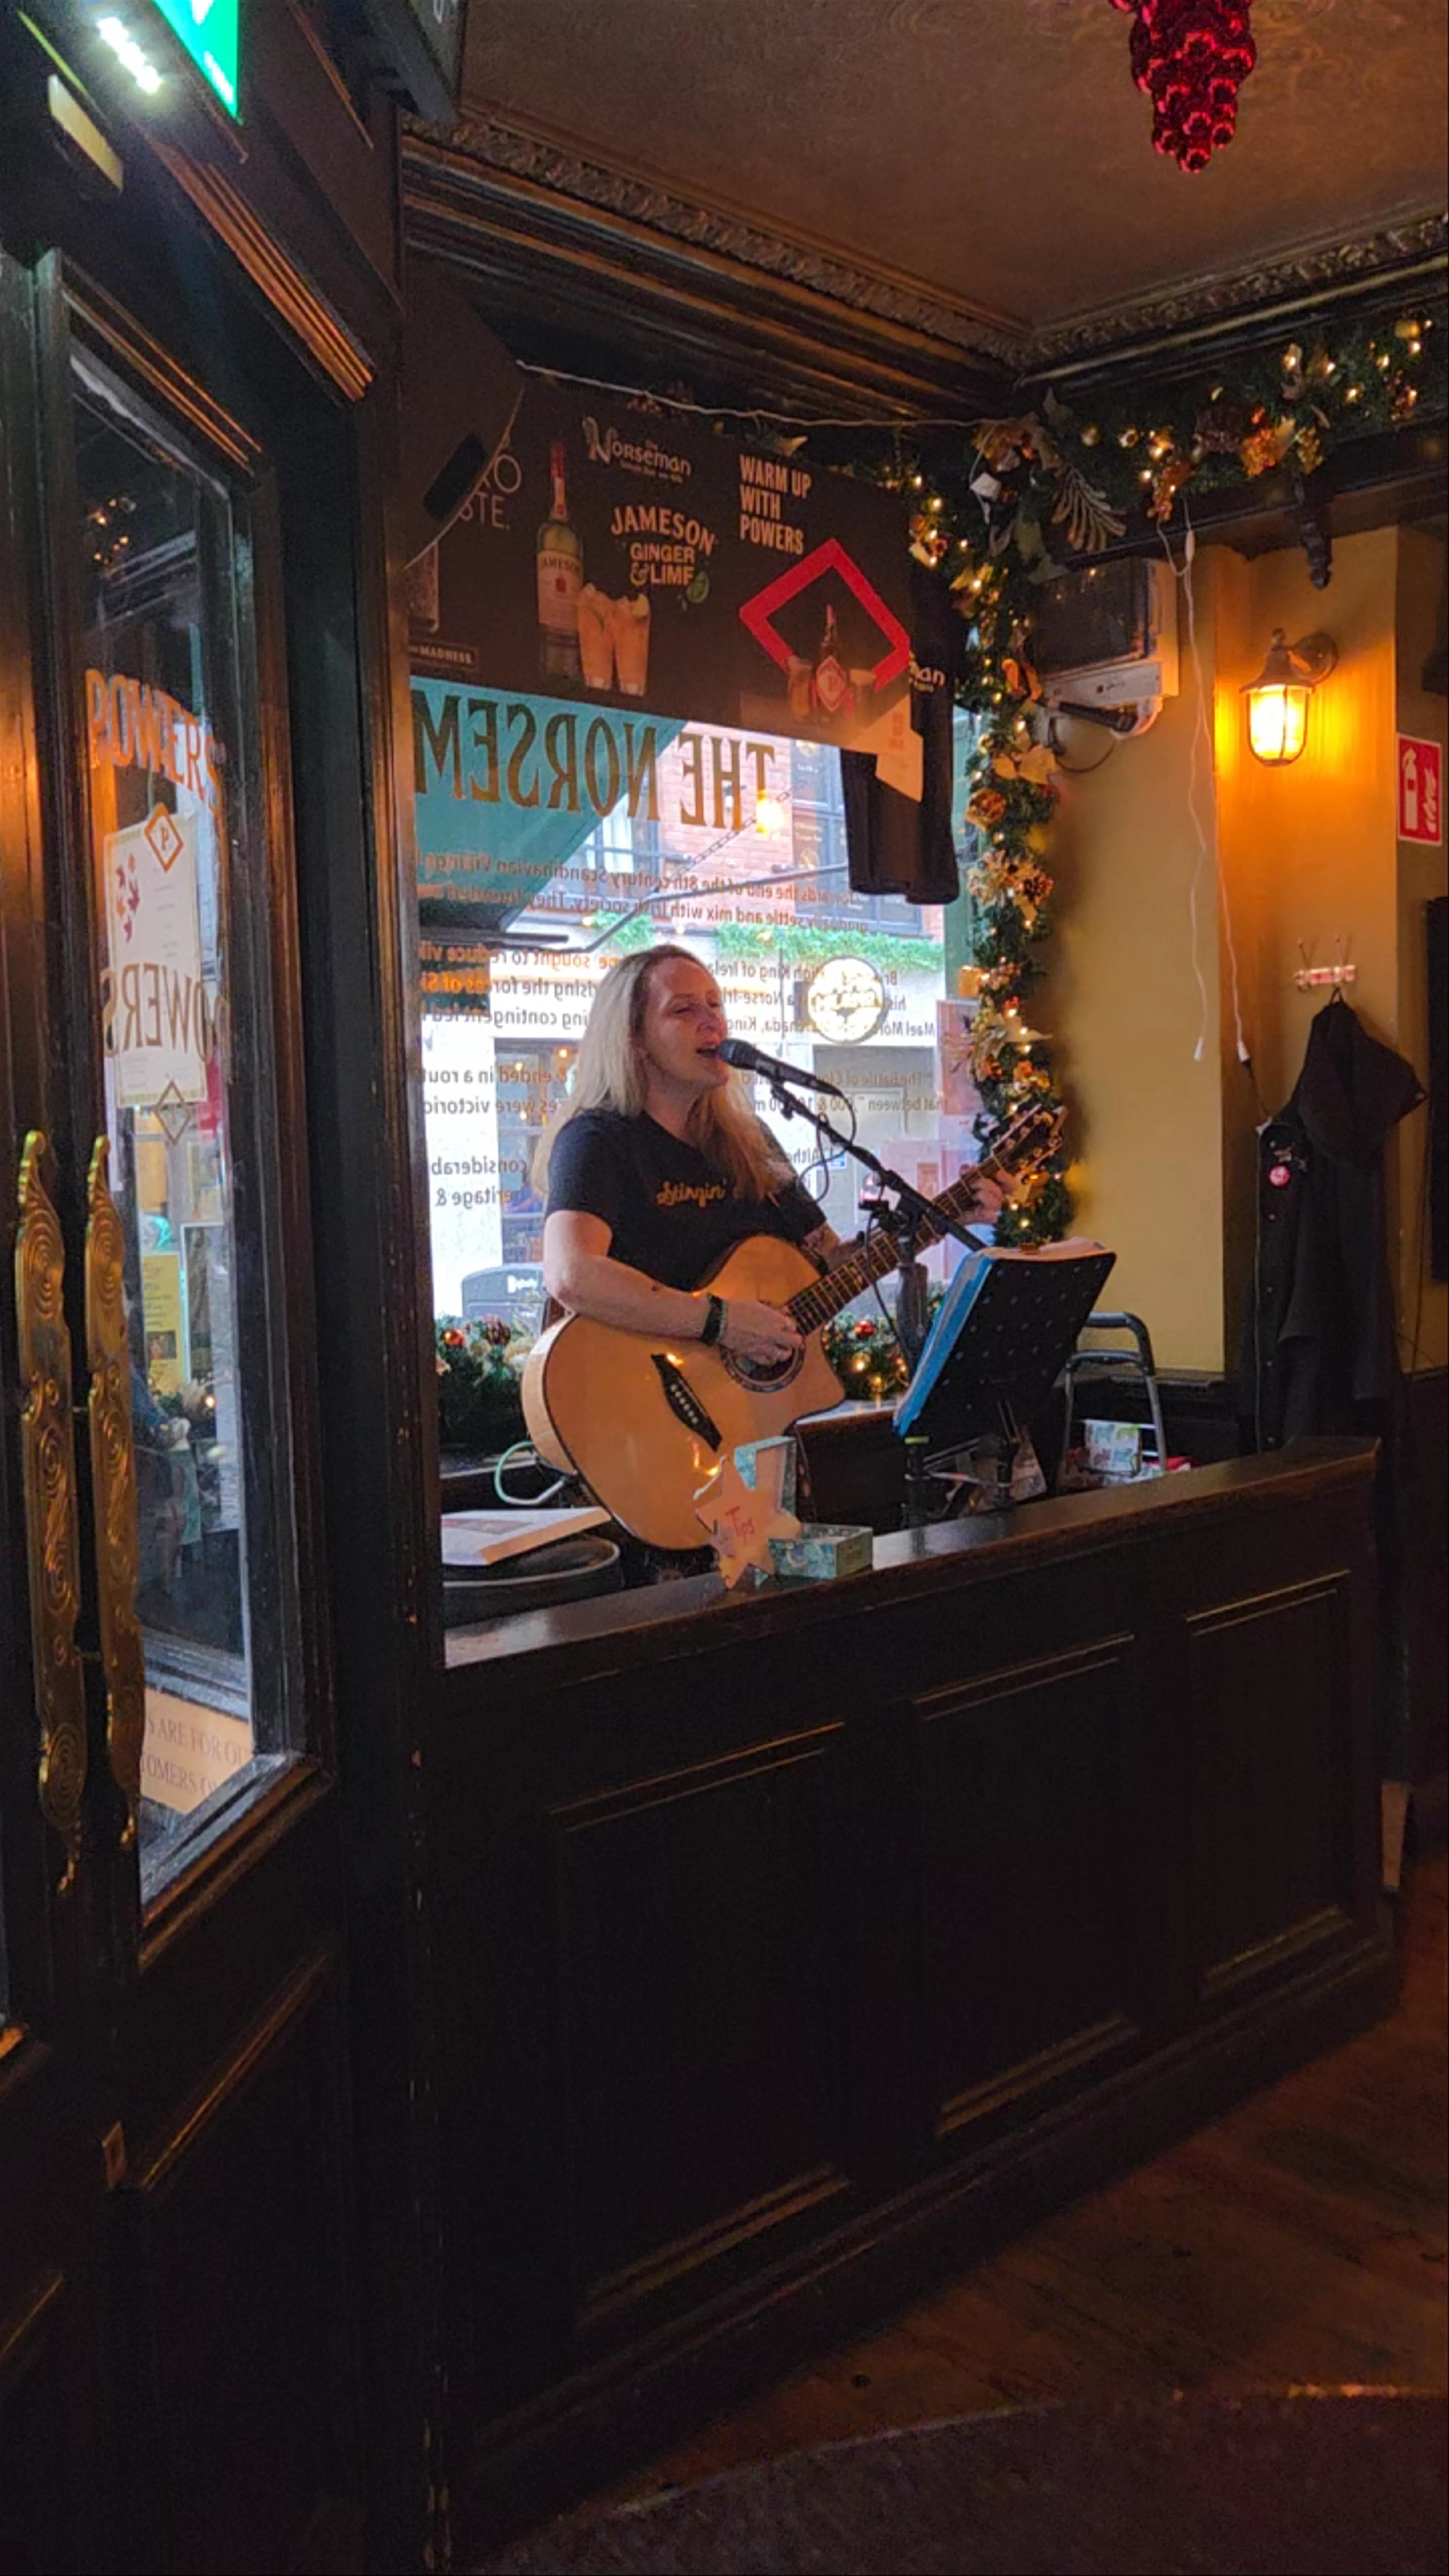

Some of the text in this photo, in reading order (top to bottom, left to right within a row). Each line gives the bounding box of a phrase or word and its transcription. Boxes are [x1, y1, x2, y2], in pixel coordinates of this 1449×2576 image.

[739, 454, 812, 499] WARM UP
[739, 484, 781, 520] WITH
[611, 505, 715, 557] JAMESON
[740, 515, 804, 555] POWERS
[630, 542, 695, 563] GINGER
[725, 1505, 755, 1544] Tips
[157, 1718, 186, 1746] ARE
[192, 1727, 222, 1761] FOR
